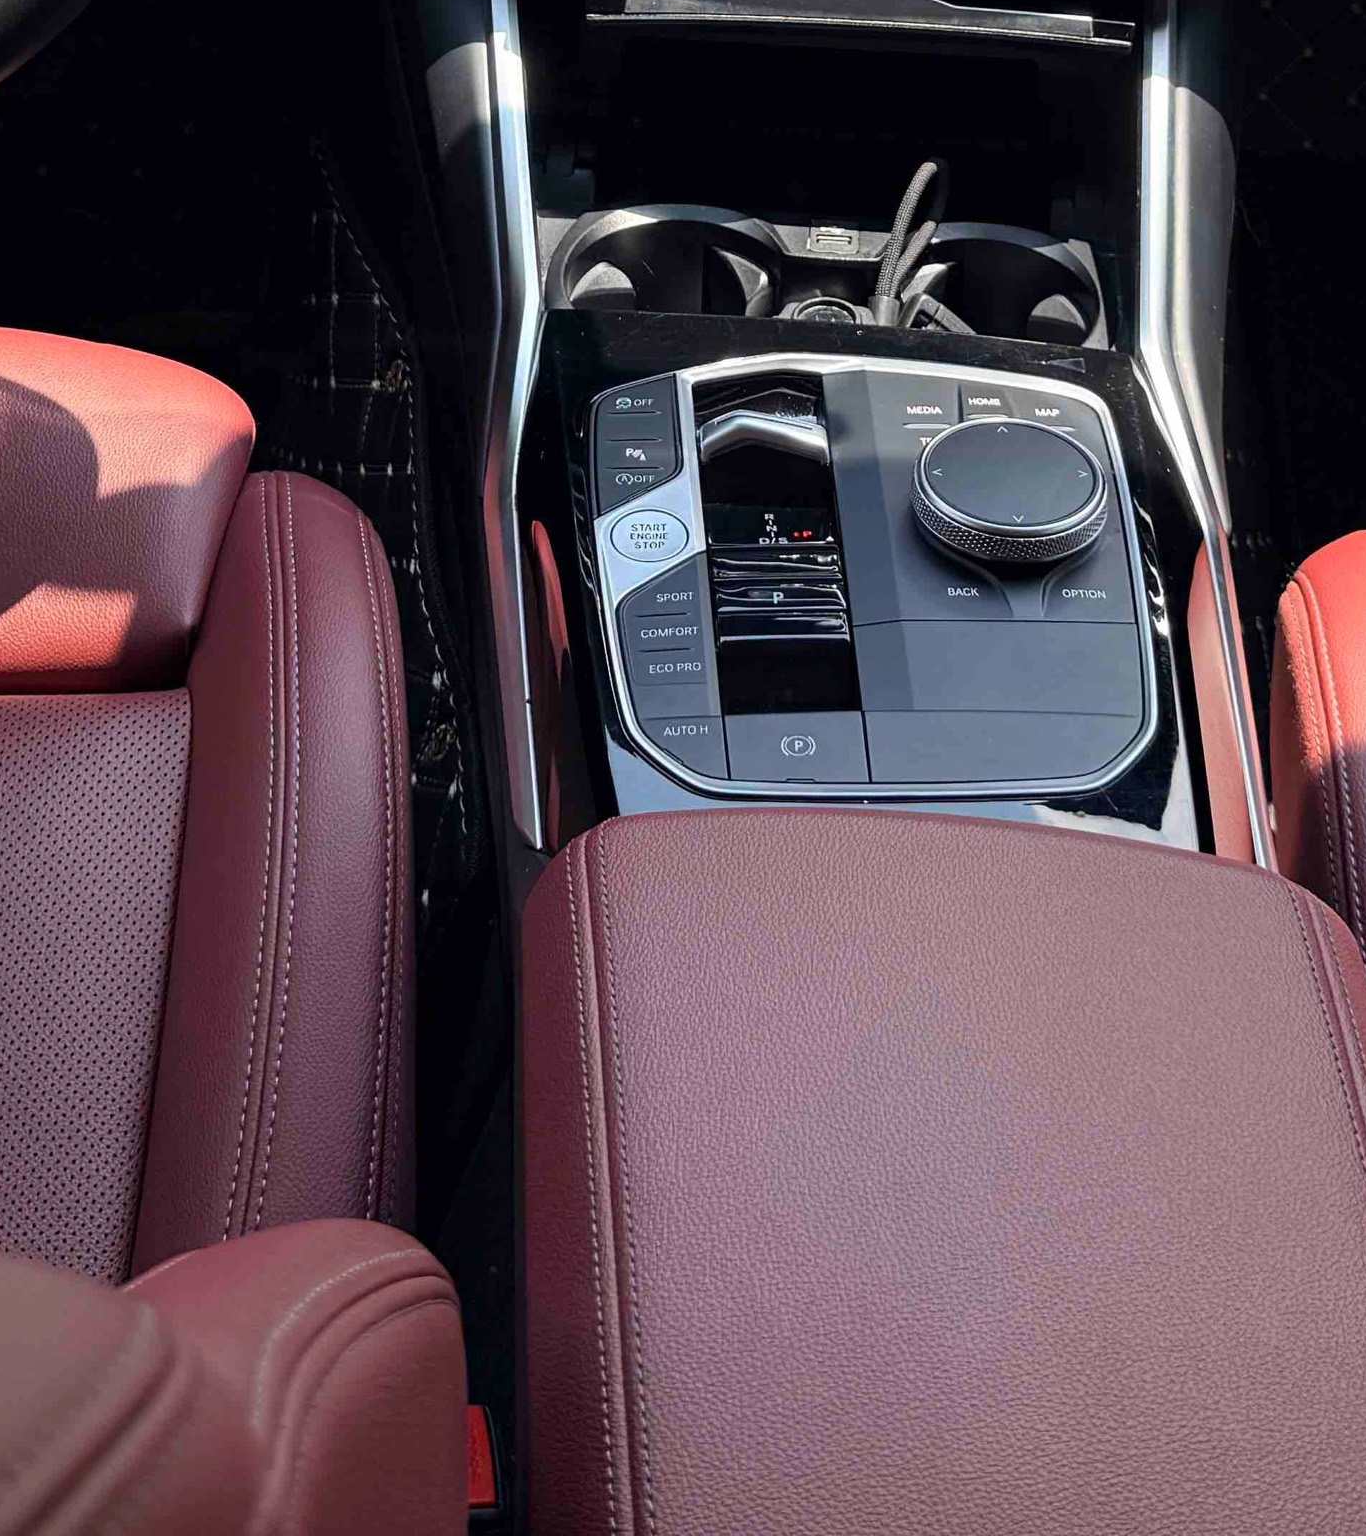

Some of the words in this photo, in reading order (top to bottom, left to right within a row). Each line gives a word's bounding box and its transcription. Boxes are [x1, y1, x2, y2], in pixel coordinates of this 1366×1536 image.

[634, 398, 654, 406] OFF
[968, 397, 1001, 406] HOME
[906, 406, 942, 415] MEDIA
[1034, 408, 1060, 417] MAP
[634, 474, 655, 483] OFF
[631, 523, 667, 532] START
[630, 532, 669, 540] ENGINE
[634, 541, 665, 549] STOP
[656, 591, 693, 603] SPORT
[947, 587, 979, 598] BACK
[1062, 588, 1106, 600] OPTION
[773, 592, 784, 604] P
[640, 626, 699, 638] COMFORT
[649, 662, 674, 674] ECO
[677, 662, 701, 672] PRO
[663, 724, 698, 737] AUTO
[699, 724, 709, 735] H
